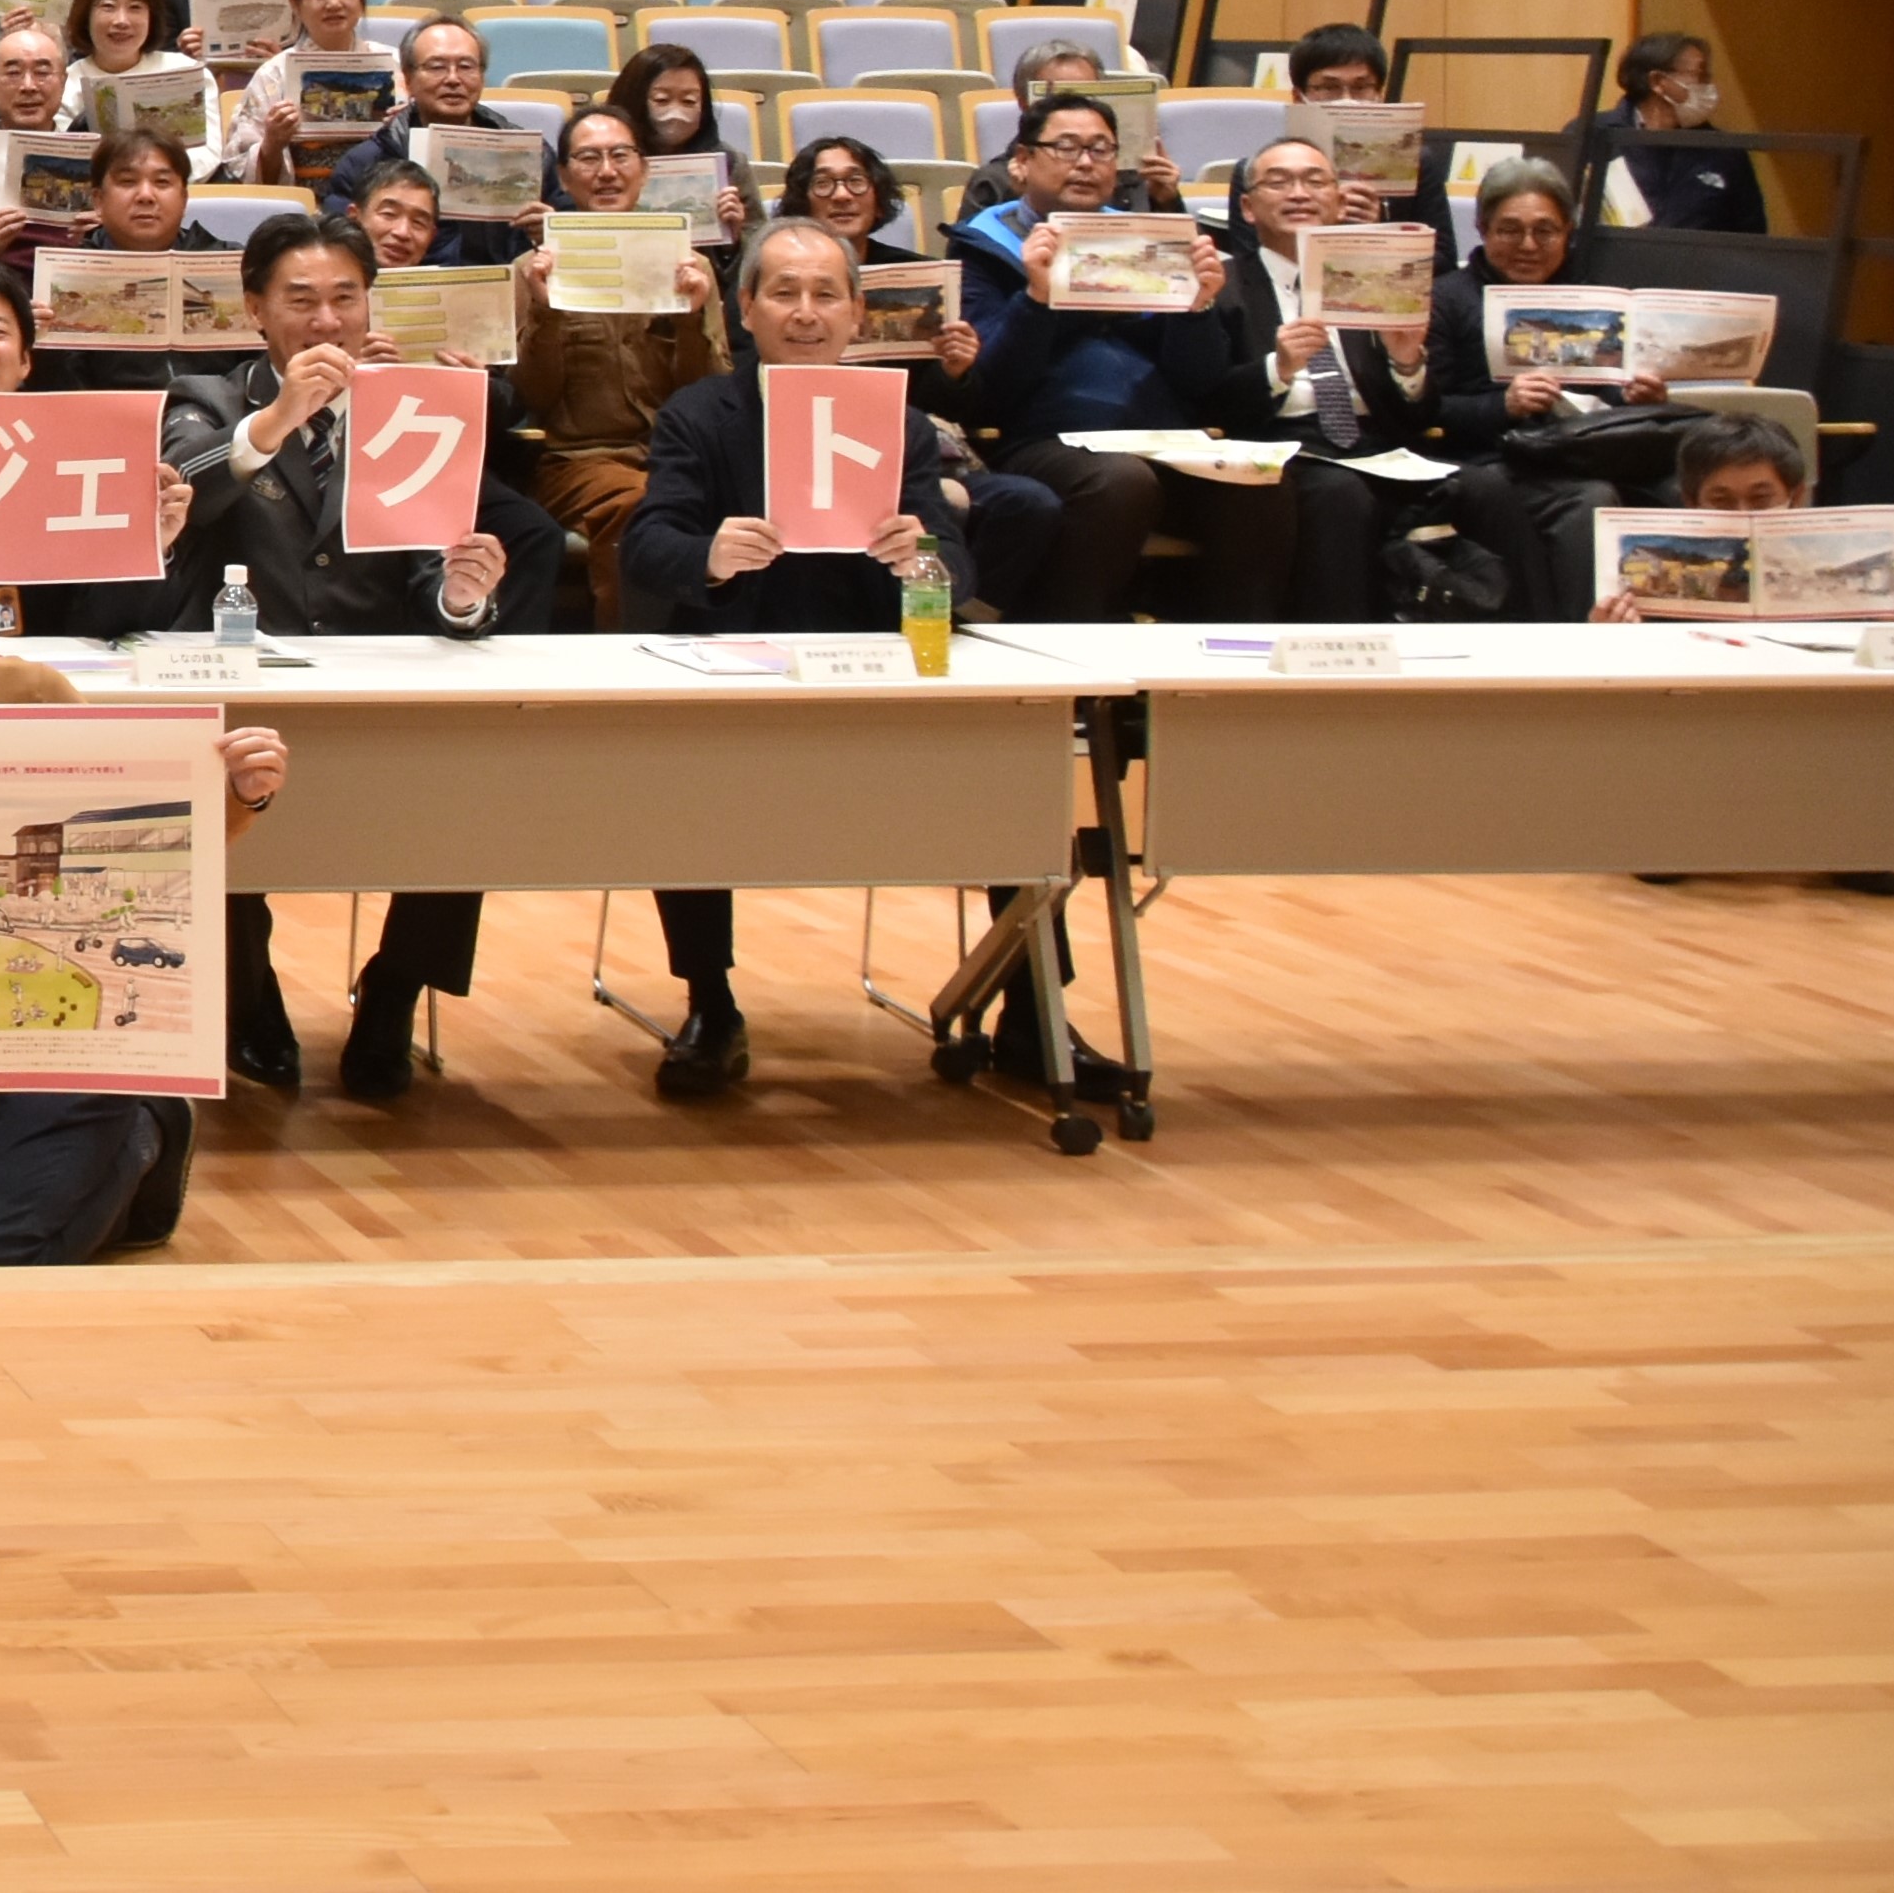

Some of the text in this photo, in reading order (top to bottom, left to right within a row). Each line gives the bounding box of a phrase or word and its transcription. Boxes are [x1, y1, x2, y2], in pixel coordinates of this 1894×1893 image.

[362, 395, 465, 507] ク
[812, 396, 881, 509] ト
[170, 653, 224, 664] しなの鉄道
